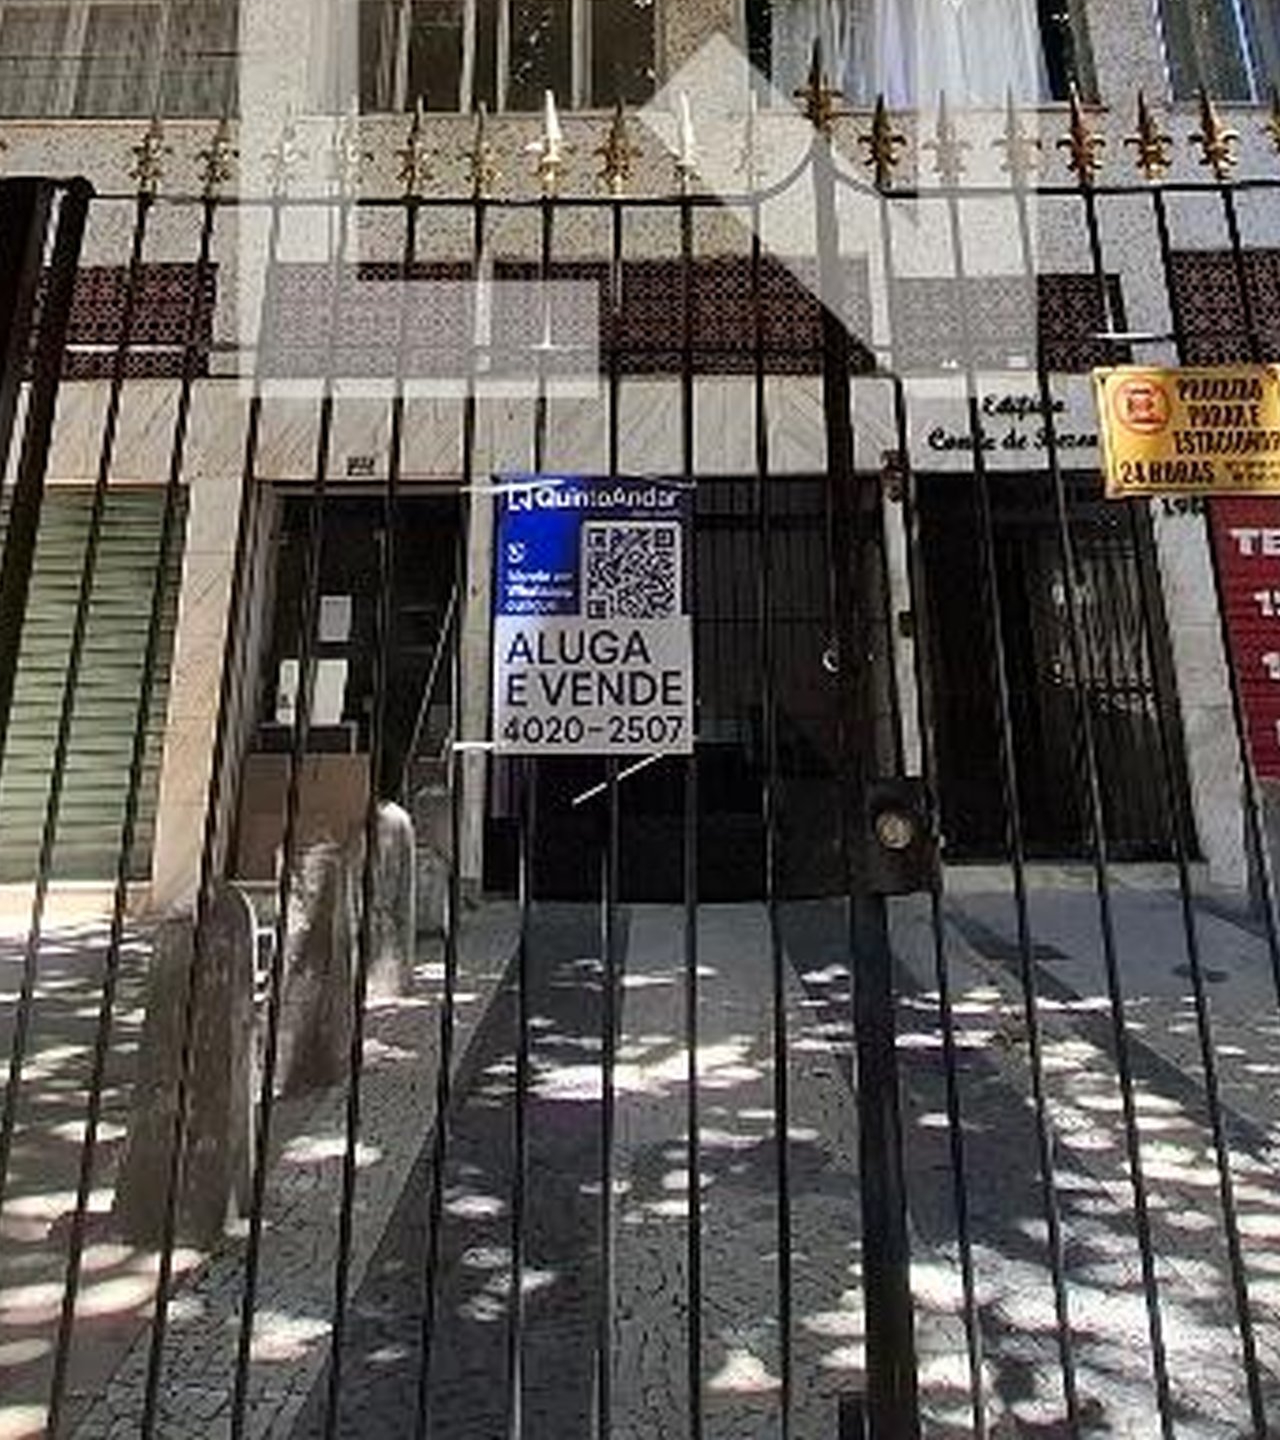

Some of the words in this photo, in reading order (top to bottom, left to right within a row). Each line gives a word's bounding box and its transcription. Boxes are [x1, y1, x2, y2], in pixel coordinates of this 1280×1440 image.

[505, 630, 651, 664] ALUGA
[509, 674, 527, 706] E
[538, 671, 682, 707] VENDE
[504, 716, 683, 744] 4020-2507
